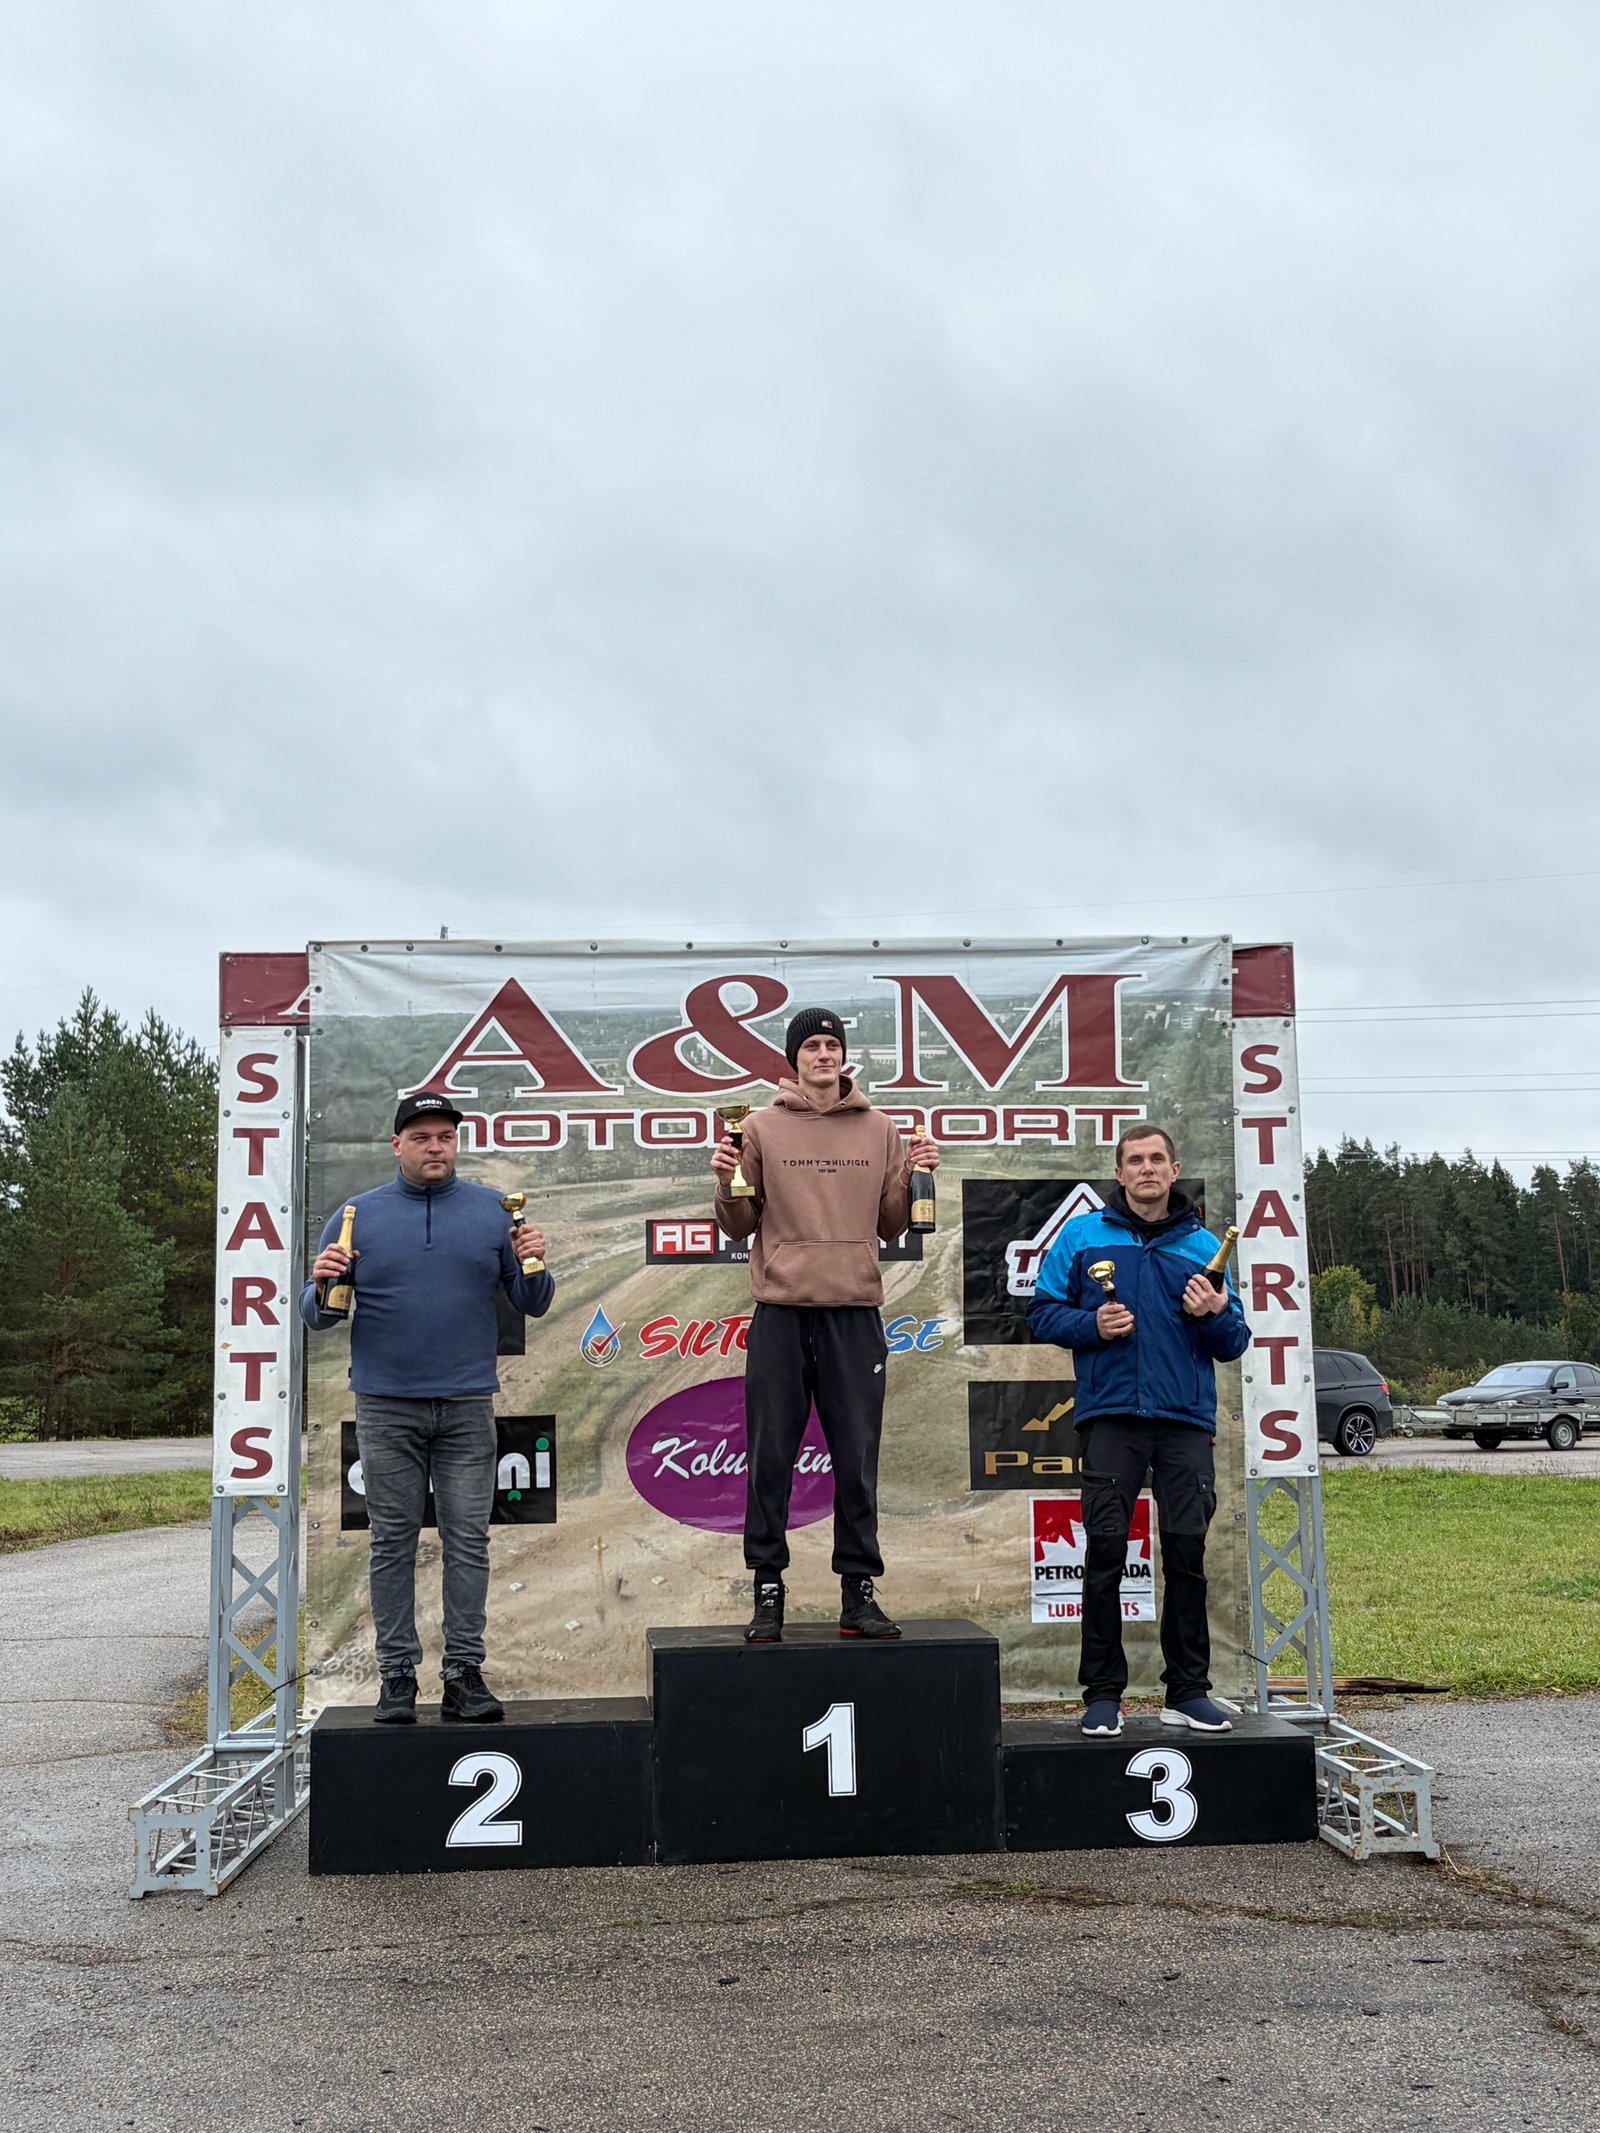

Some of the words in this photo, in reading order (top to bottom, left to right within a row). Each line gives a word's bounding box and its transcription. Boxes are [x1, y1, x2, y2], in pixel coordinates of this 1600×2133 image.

[225, 1052, 285, 1480] STARTS
[655, 1223, 713, 1252] AG
[1240, 1044, 1302, 1462] STARTS
[803, 1702, 857, 1797] 1
[1125, 1747, 1198, 1842] 3
[445, 1751, 523, 1848] 2
